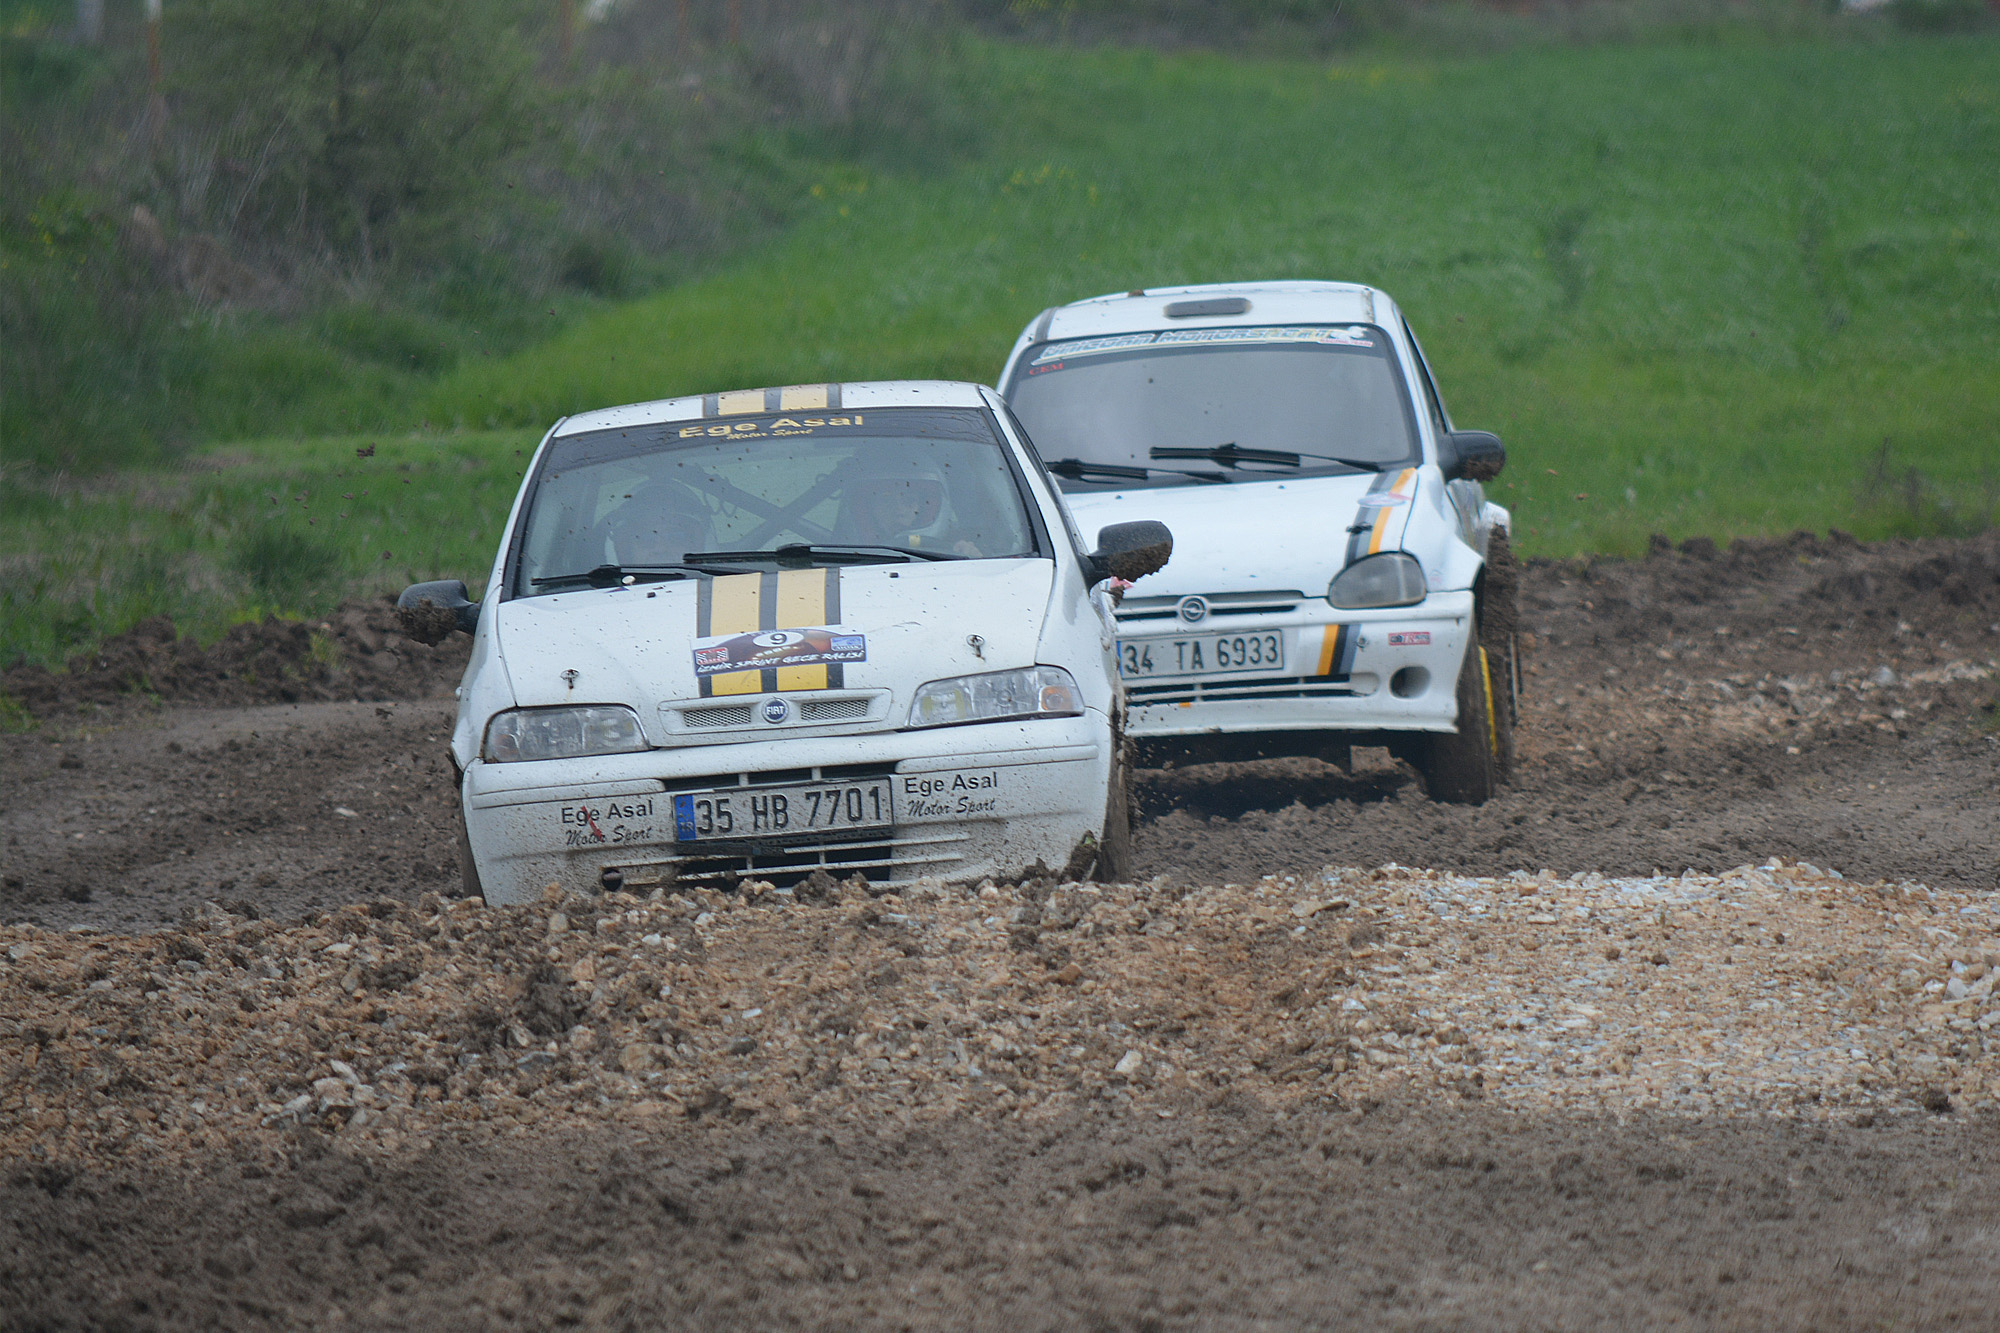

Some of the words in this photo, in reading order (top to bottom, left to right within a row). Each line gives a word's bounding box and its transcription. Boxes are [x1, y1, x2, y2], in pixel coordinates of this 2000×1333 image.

[678, 423, 758, 439] Ege
[769, 415, 863, 429] Asal
[769, 633, 788, 645] 9
[1124, 645, 1154, 674] 34
[1174, 641, 1204, 670] TA
[1217, 635, 1278, 667] 6933
[766, 705, 785, 716] FIAT
[905, 777, 945, 797] Ege
[952, 772, 998, 791] Asal
[561, 806, 600, 827] Ege
[607, 800, 653, 819] Asal
[696, 798, 733, 834] 35
[751, 794, 789, 831] HB
[805, 786, 882, 826] 7701
[908, 799, 950, 817] Motor
[956, 796, 996, 818] Sport
[612, 824, 653, 845] Sport
